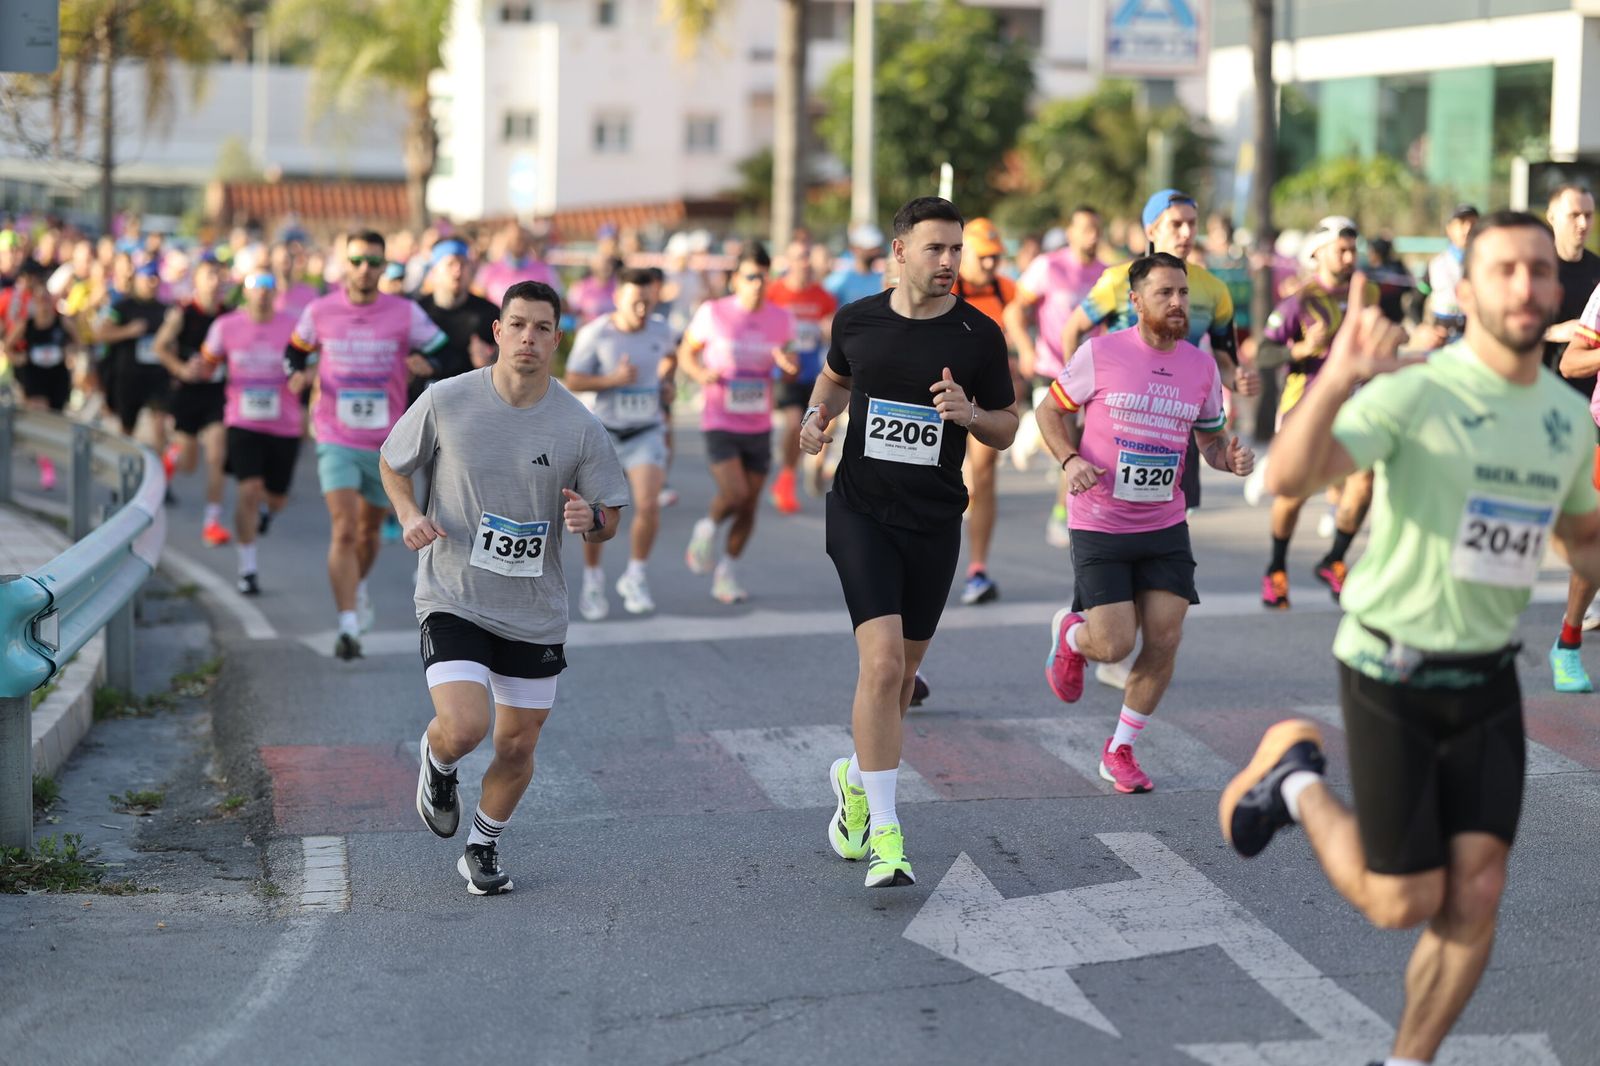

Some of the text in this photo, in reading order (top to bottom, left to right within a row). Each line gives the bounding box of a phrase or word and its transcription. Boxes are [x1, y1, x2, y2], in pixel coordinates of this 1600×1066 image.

[1148, 382, 1180, 398] XXXVI
[1105, 393, 1149, 412] MEDIA
[1110, 408, 1178, 431] INTERNACIONAL
[869, 416, 938, 447] 2206
[1121, 465, 1175, 487] 1320
[483, 530, 542, 558] 1393
[1465, 521, 1542, 557] 2041
